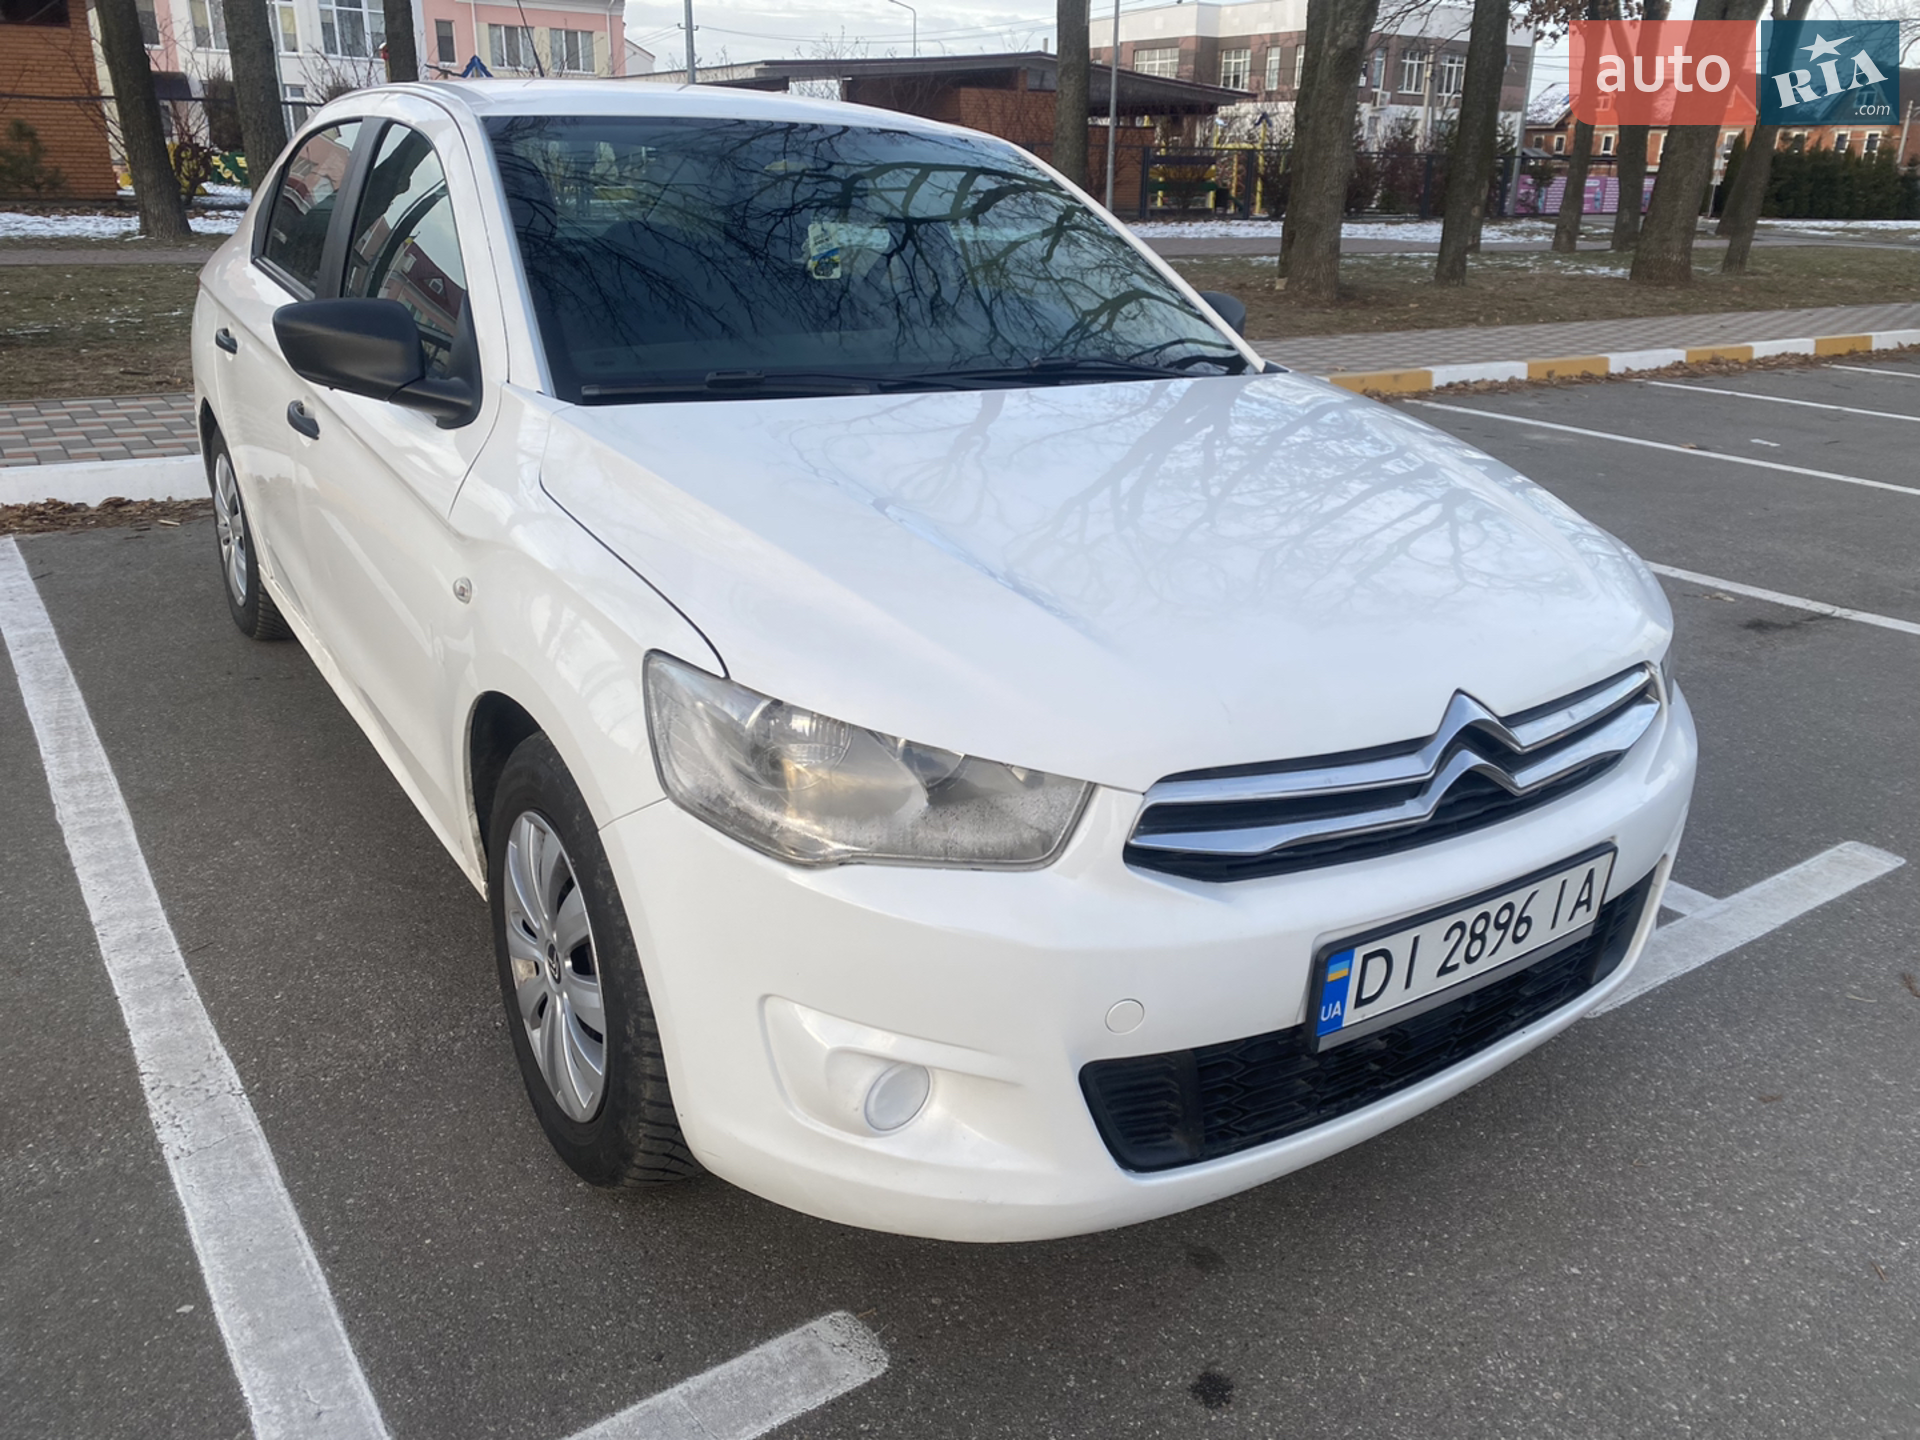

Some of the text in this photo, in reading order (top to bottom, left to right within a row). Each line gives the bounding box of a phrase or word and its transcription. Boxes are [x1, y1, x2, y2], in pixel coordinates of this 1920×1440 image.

[1354, 868, 1595, 1009] DI 2896 IA
[1321, 1000, 1342, 1022] UA
